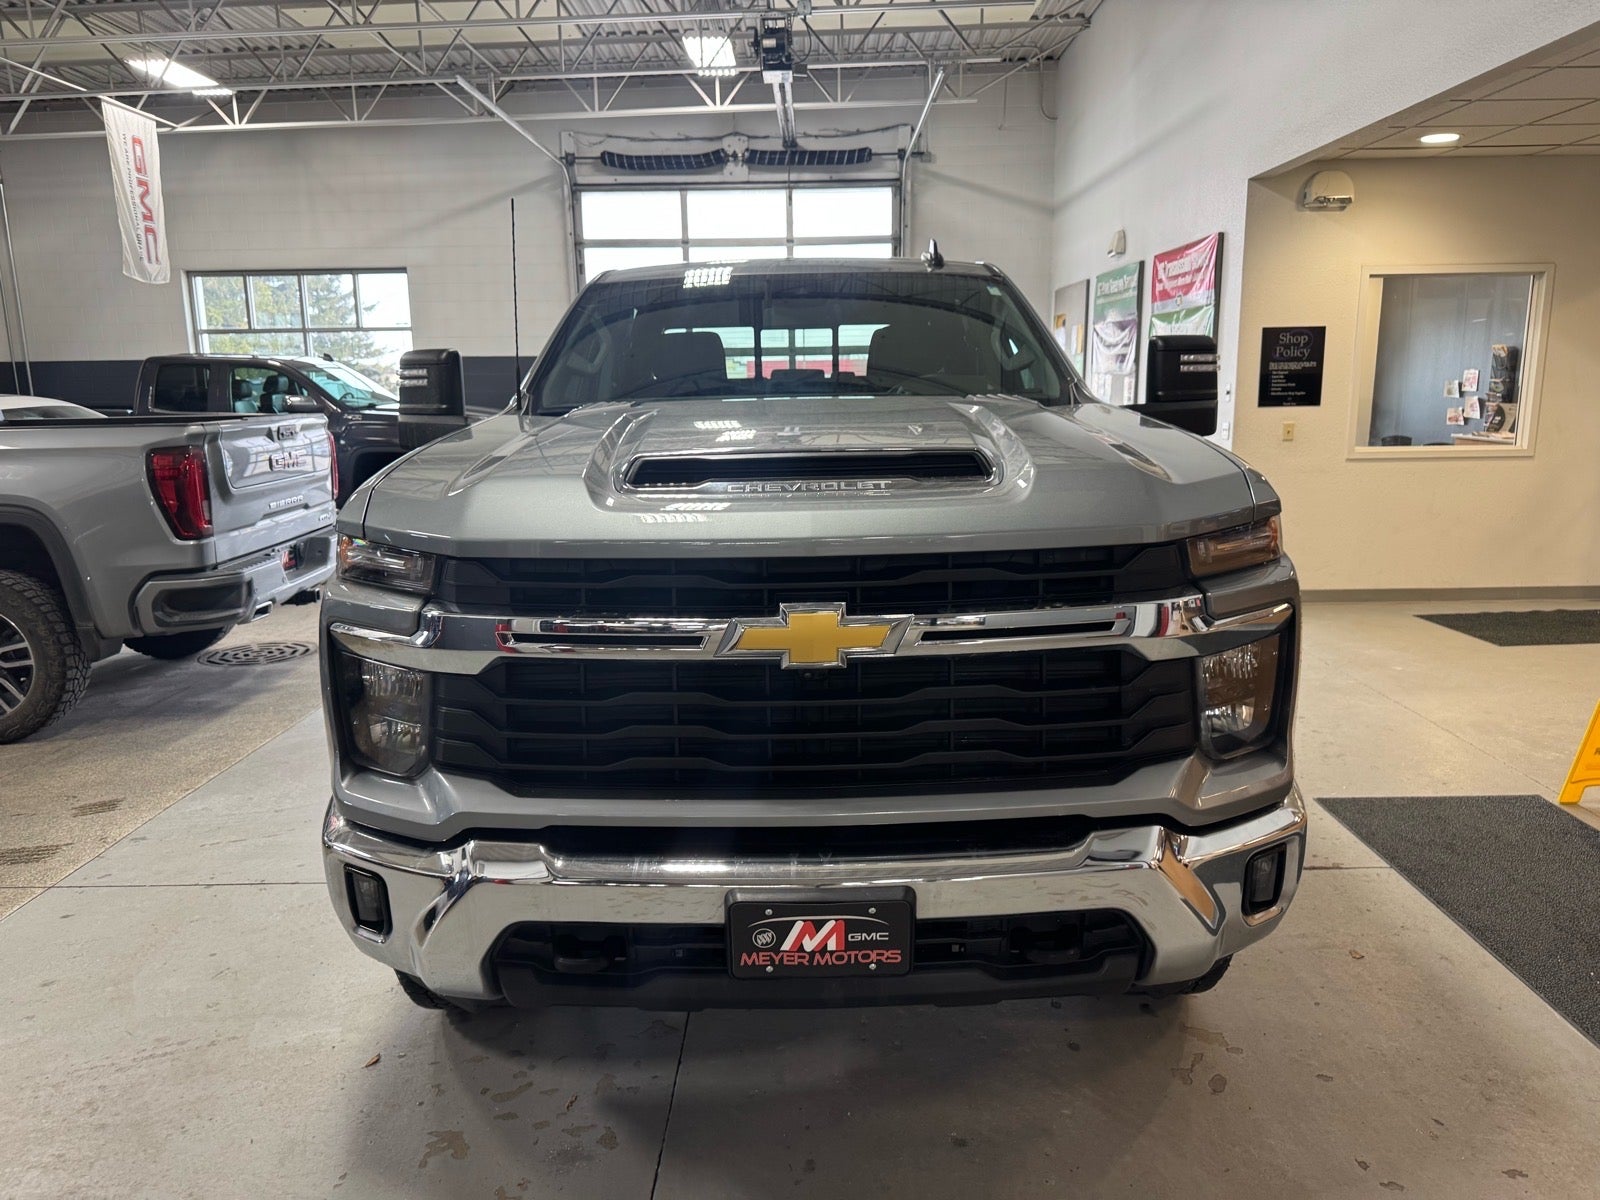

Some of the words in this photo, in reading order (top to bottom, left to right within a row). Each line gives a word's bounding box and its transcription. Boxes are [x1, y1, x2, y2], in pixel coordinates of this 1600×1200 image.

[132, 135, 161, 265] GMC
[1279, 332, 1309, 347] Shop
[1275, 346, 1311, 360] Policy
[269, 449, 307, 471] GMC
[727, 480, 892, 493] CHEVROLET
[848, 932, 889, 941] GMC
[739, 951, 810, 967] MEYER
[813, 949, 902, 966] MOTORS
